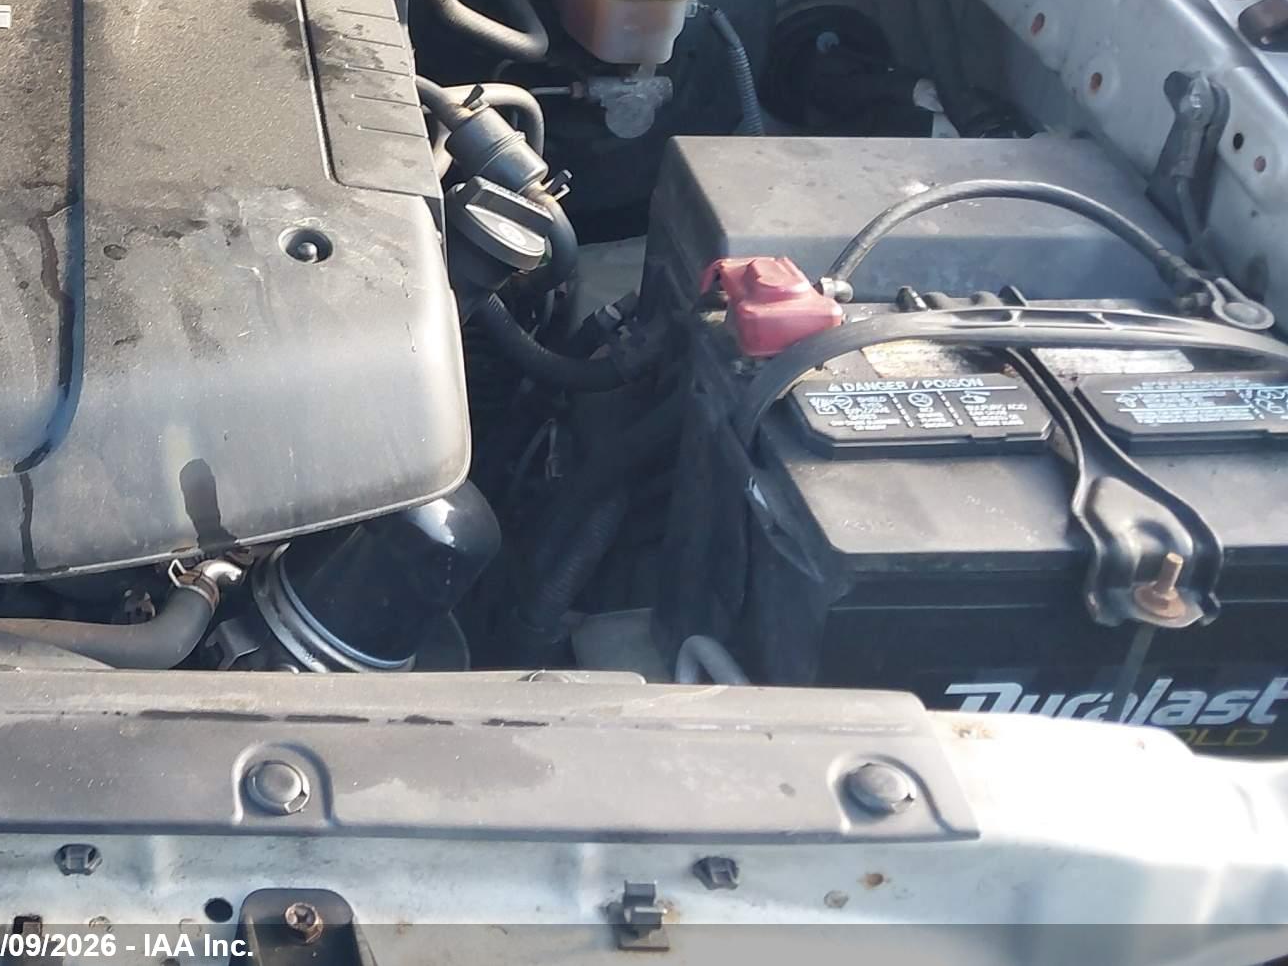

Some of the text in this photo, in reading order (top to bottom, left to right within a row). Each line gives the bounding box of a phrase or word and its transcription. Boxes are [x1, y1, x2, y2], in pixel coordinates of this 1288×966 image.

[841, 377, 984, 393] DANGER / POISON
